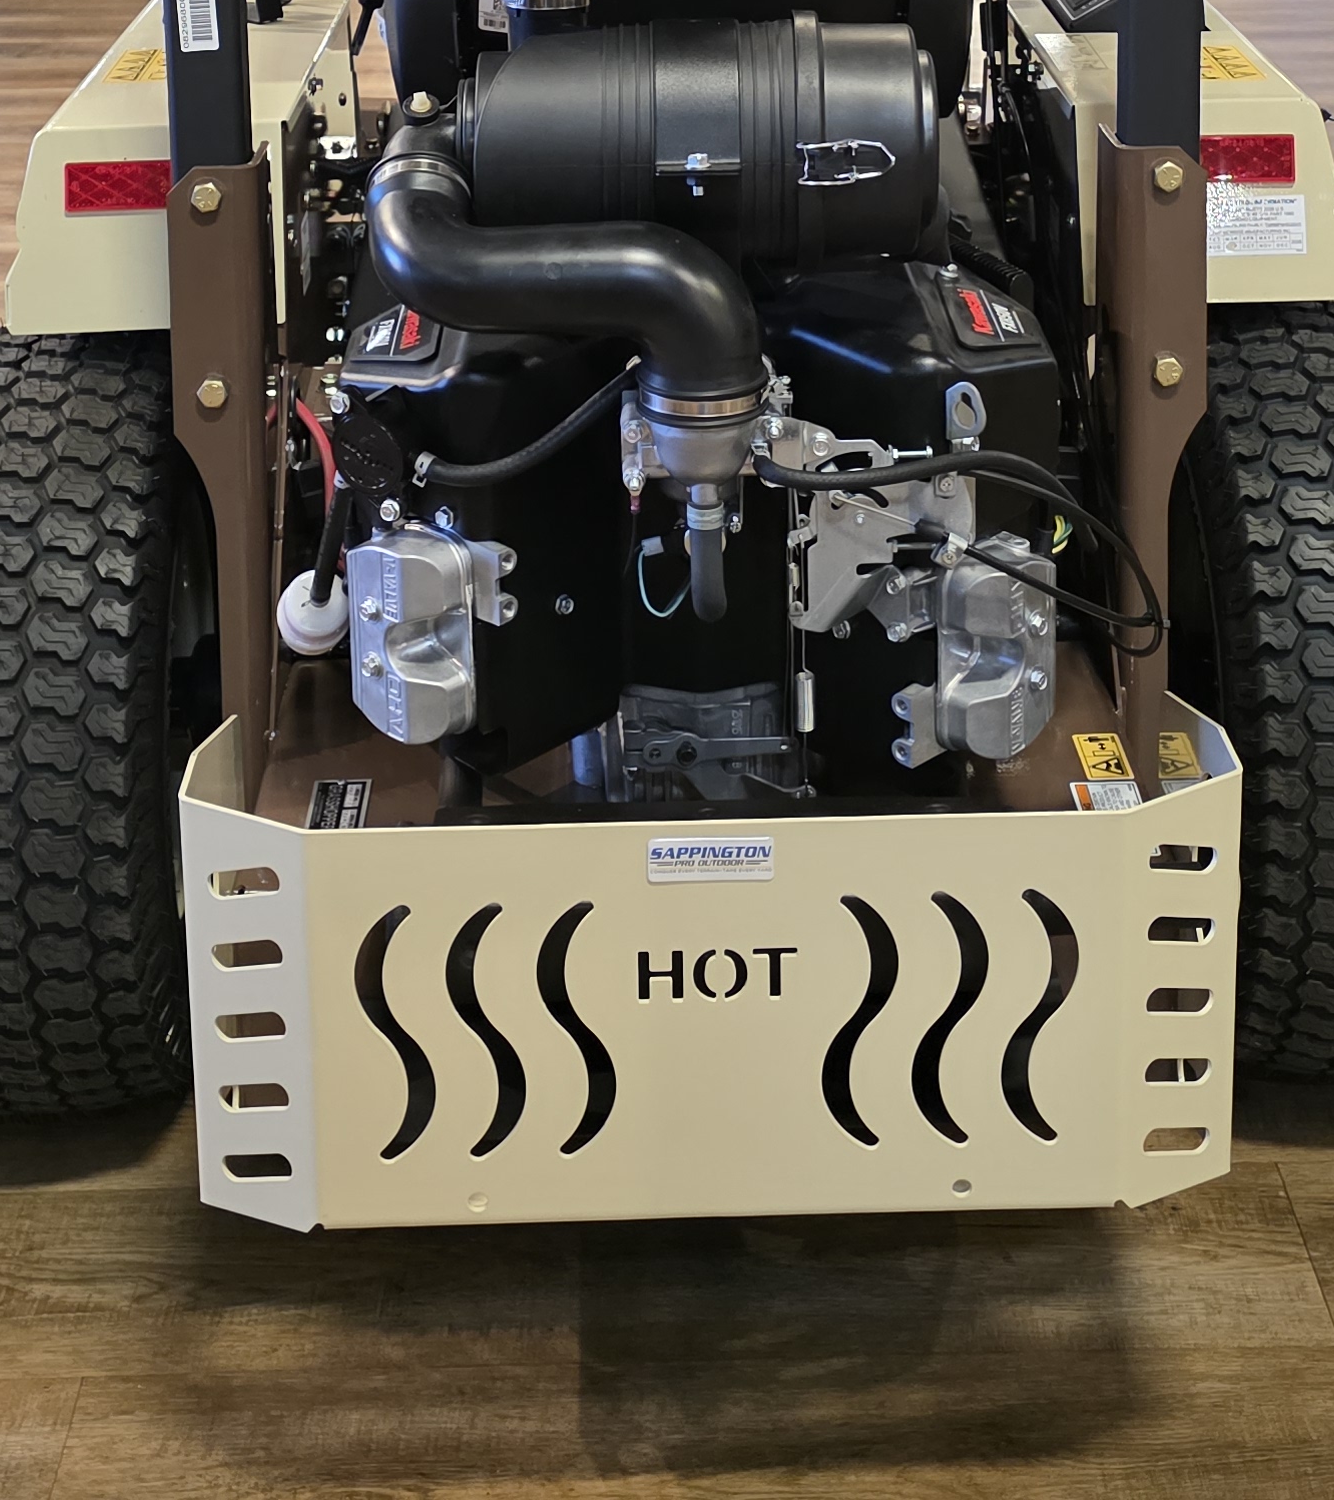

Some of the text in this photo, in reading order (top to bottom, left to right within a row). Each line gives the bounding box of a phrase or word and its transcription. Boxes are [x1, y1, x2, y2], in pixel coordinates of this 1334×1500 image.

[649, 845, 772, 860] SAPPINGTON
[697, 859, 744, 867] OUTDOOR
[637, 947, 798, 1000] HOT
